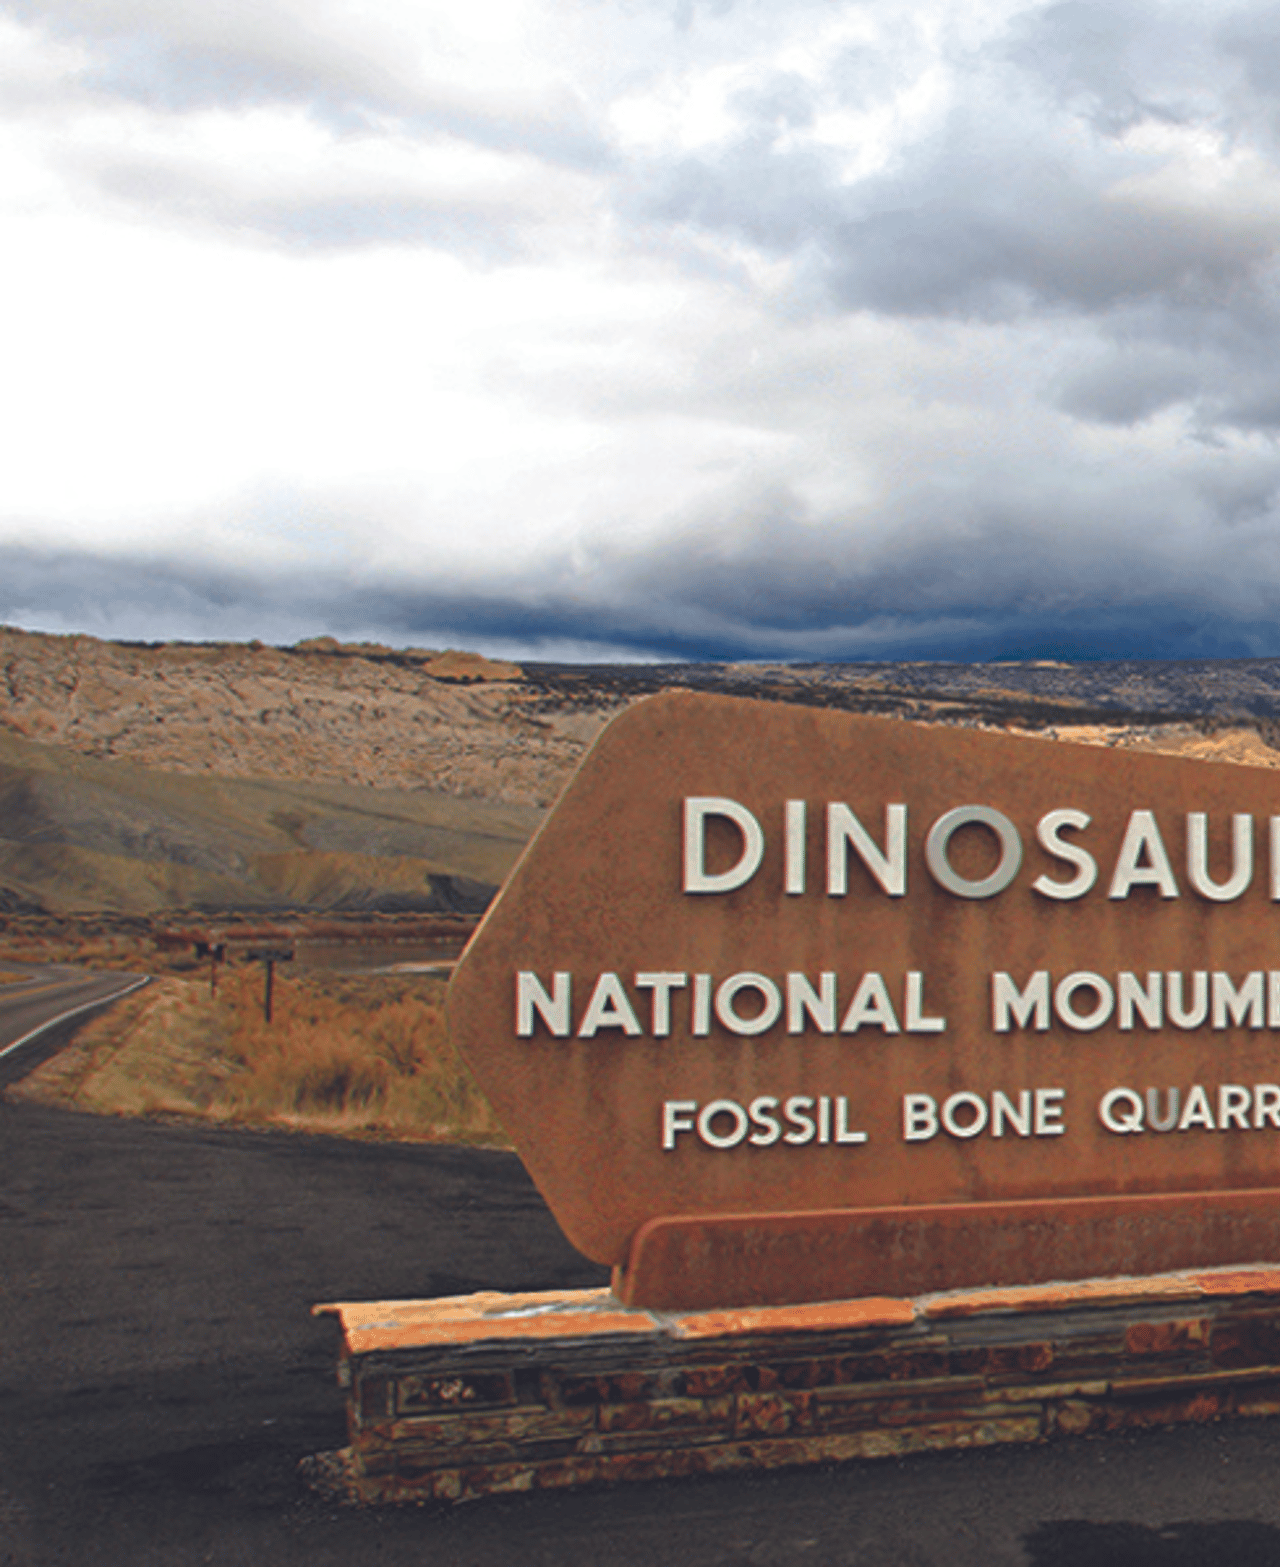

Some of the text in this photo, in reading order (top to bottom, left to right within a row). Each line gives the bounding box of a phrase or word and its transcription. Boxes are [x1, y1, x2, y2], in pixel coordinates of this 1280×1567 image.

[515, 970, 946, 1038] NATIONAL
[662, 1096, 867, 1150] FOSSIL
[903, 1088, 1066, 1141] BONE
